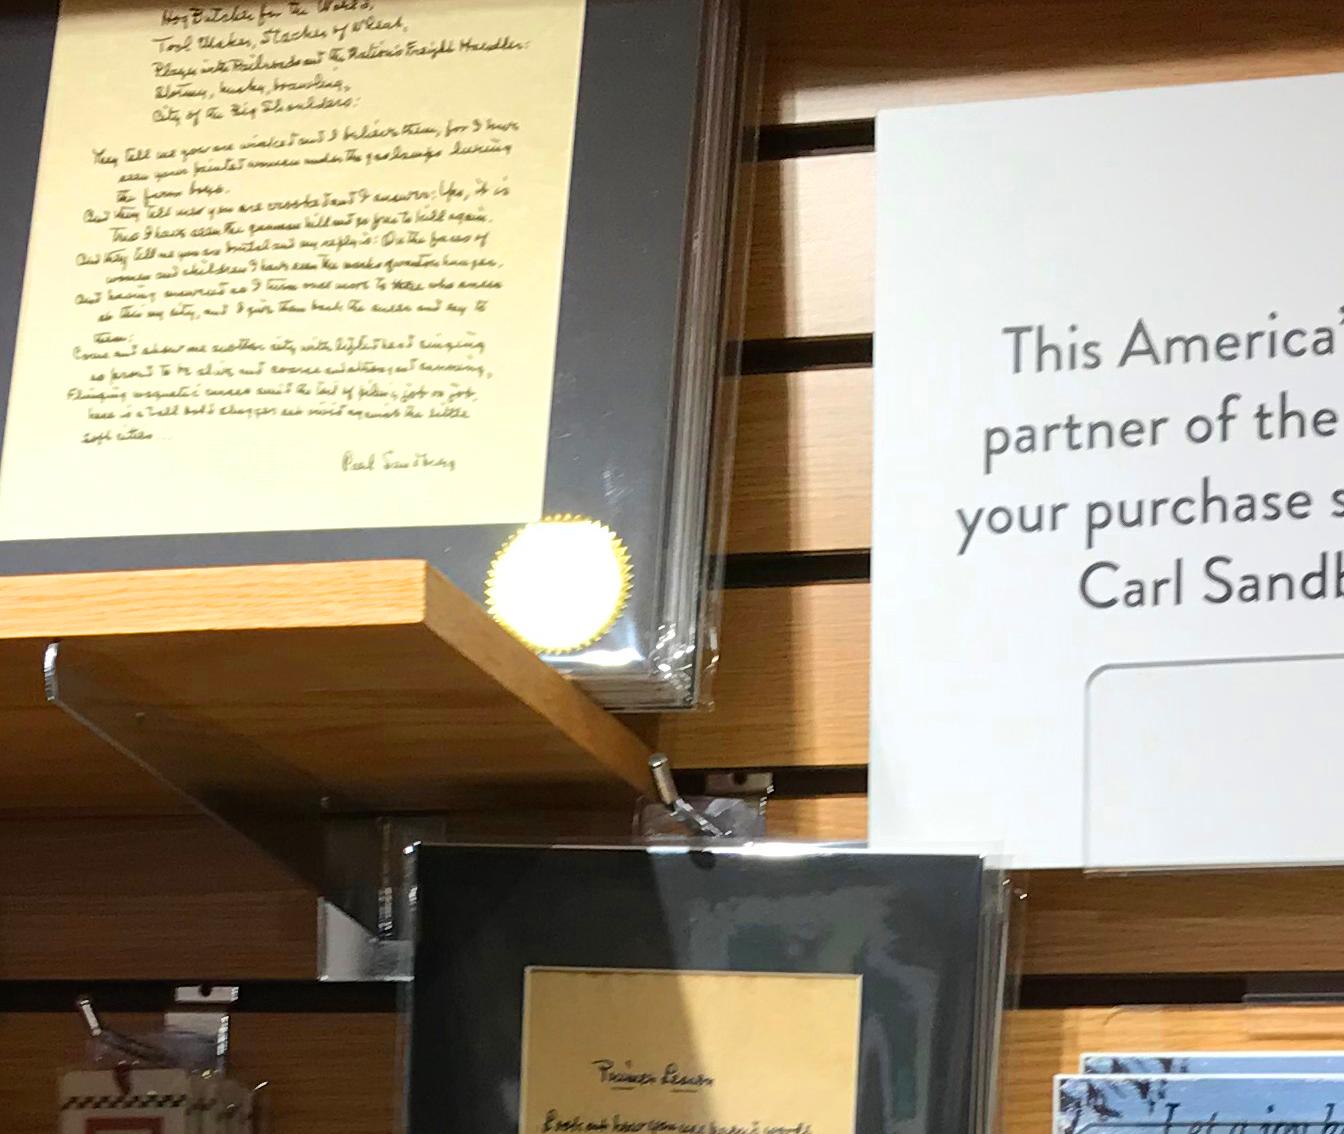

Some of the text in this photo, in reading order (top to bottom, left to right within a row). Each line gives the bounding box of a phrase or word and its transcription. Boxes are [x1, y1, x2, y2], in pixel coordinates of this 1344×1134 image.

[1003, 325, 1101, 373] This
[985, 415, 1169, 474] partner
[1186, 394, 1241, 443] of
[1254, 391, 1338, 440] the
[957, 503, 1068, 555] your
[1087, 477, 1311, 549] purchase
[1080, 558, 1182, 608] Carl
